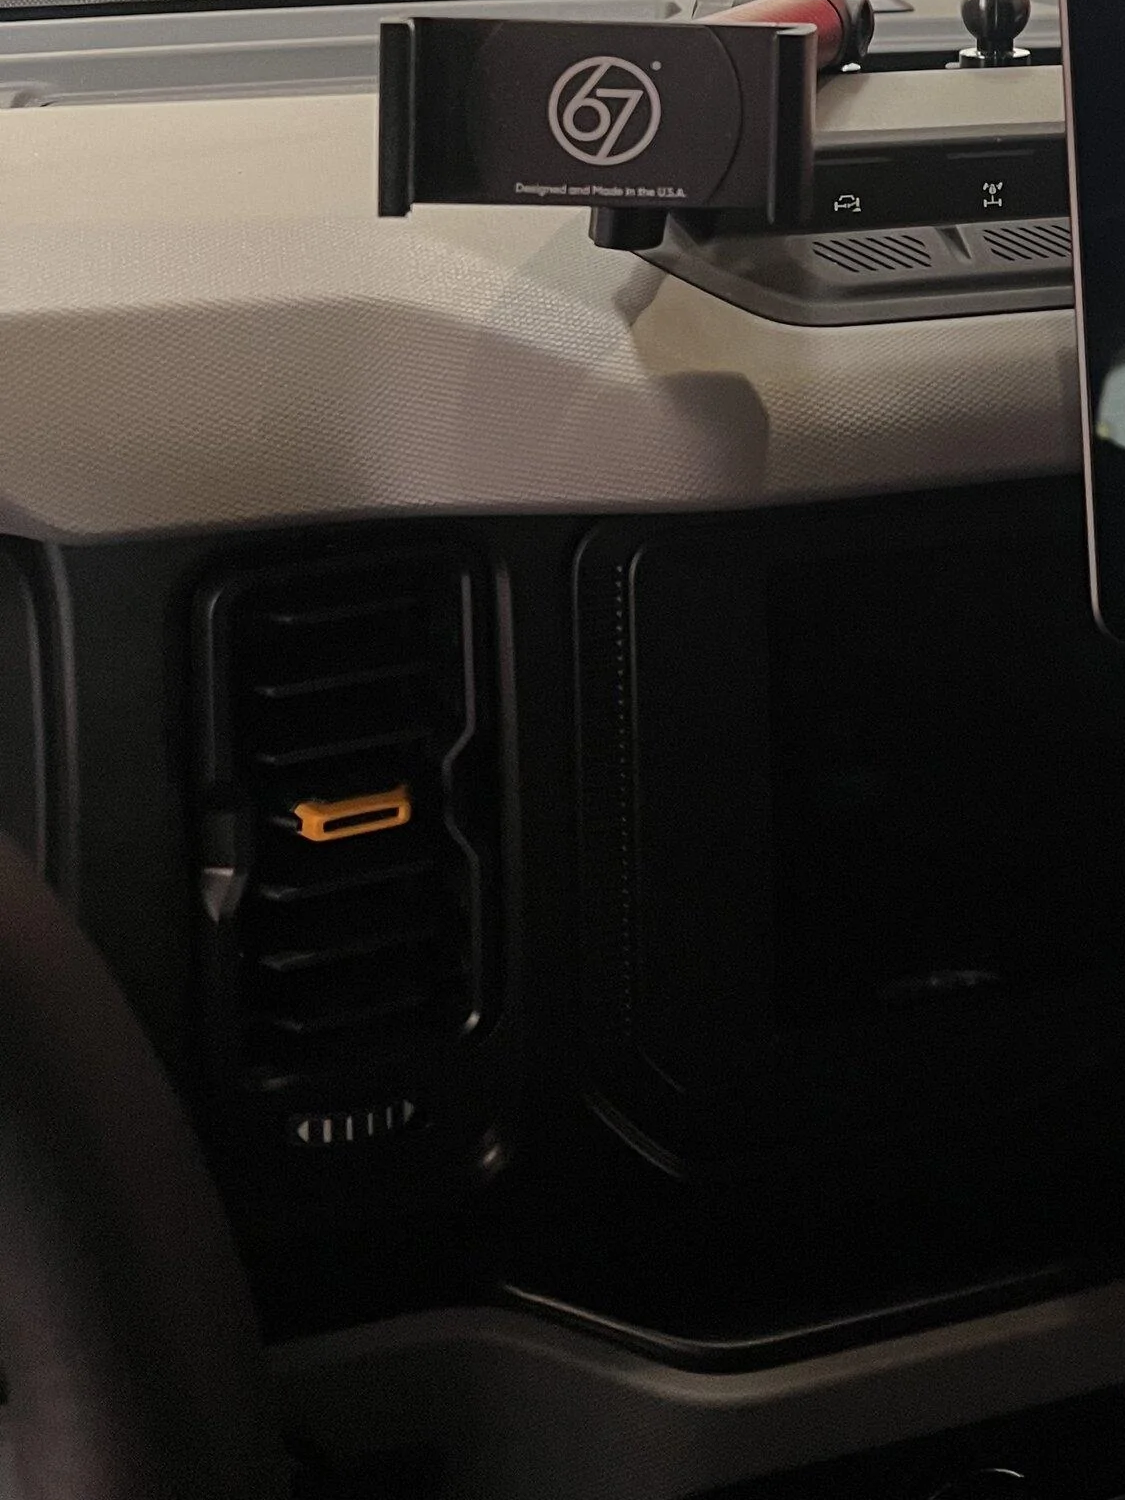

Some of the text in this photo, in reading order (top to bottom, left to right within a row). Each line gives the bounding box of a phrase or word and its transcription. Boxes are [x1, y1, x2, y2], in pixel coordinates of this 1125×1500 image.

[515, 182, 567, 197] Designed
[568, 185, 591, 196] and
[592, 185, 624, 197] Made
